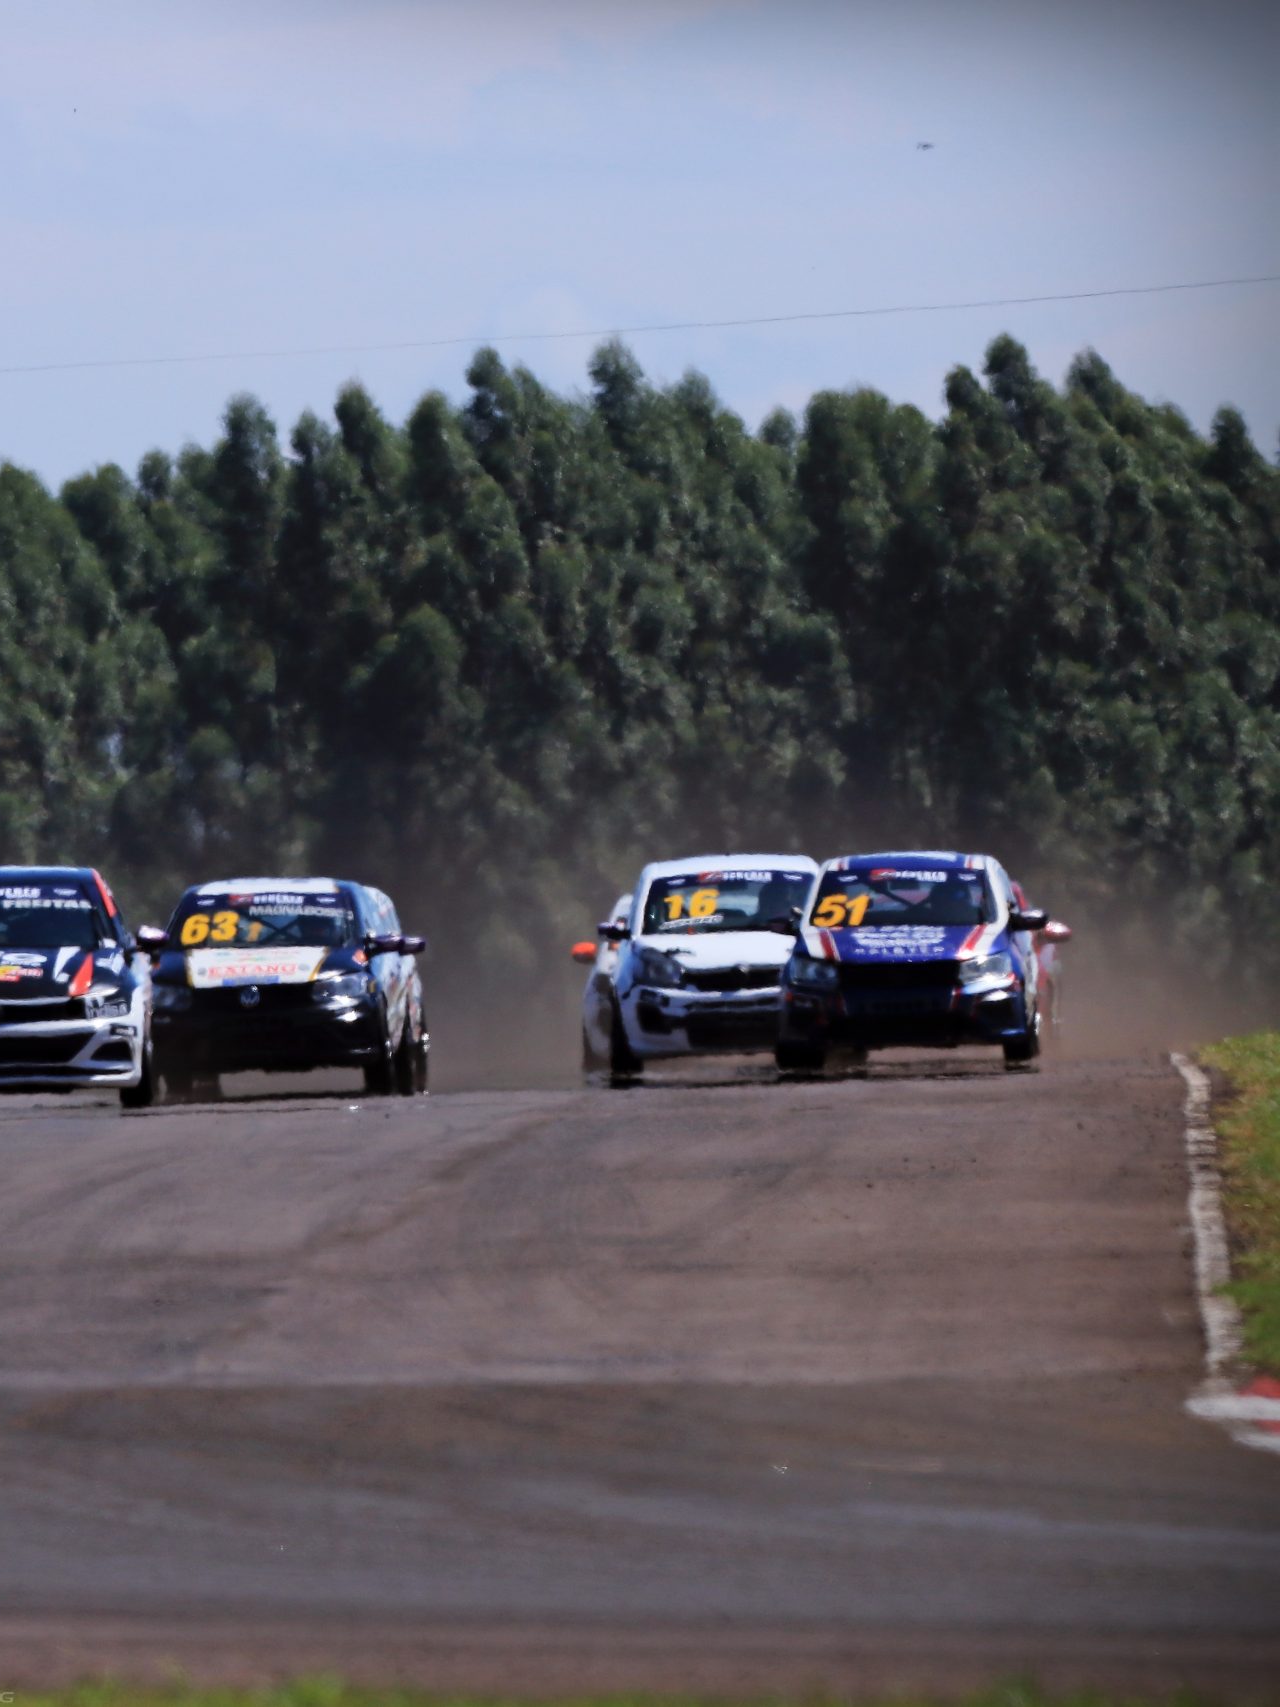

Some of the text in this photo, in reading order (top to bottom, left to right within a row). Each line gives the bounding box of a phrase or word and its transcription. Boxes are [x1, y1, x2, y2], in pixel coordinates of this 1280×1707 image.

[664, 888, 719, 919] 16
[813, 894, 870, 927] 51
[180, 911, 239, 945] 63
